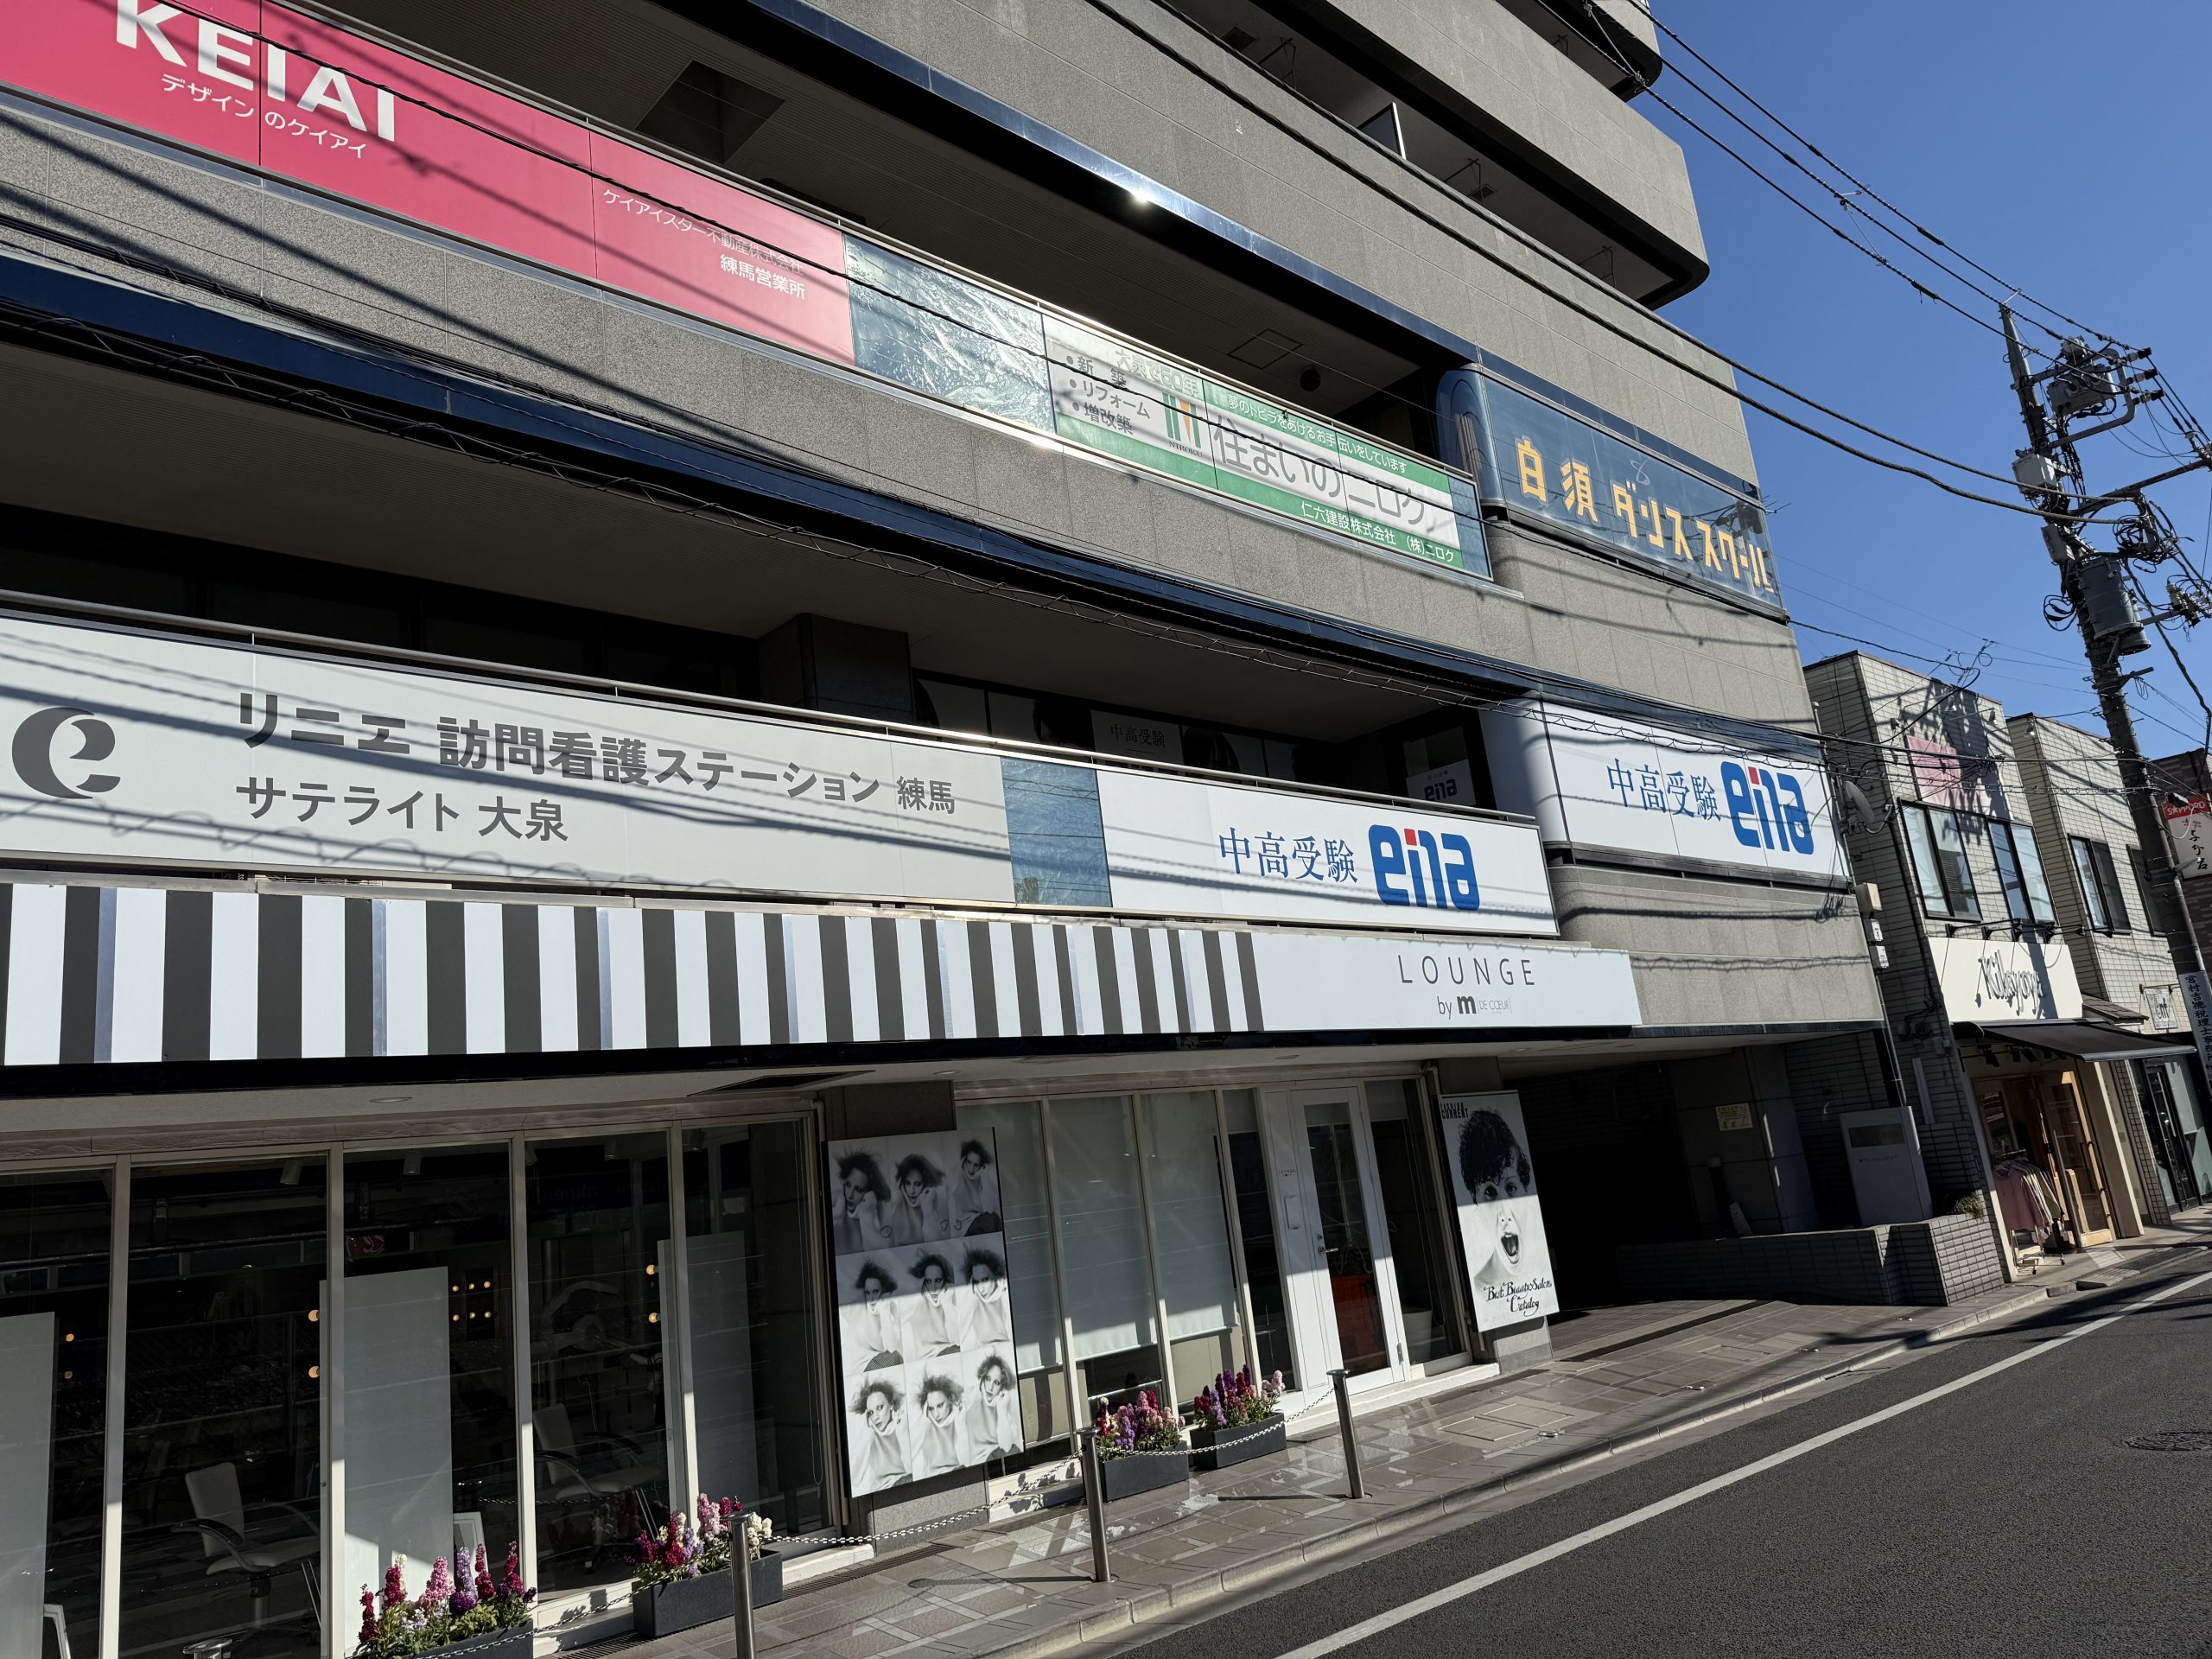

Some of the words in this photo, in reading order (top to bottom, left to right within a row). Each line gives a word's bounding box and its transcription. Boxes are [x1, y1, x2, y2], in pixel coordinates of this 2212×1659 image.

[117, 0, 395, 142] KEIAI
[720, 254, 806, 300] 練馬営業所
[1083, 380, 1151, 419] リフォーム
[1084, 402, 1134, 435] 増改築
[1168, 441, 1204, 458] NIROKU
[1212, 414, 1425, 525] 住まいのニロク
[1110, 723, 1166, 747] 中高受験
[437, 716, 880, 803] 訪問看護ステーション
[896, 775, 956, 815] 練馬
[236, 776, 460, 831] サテライト
[478, 796, 569, 842] 大泉
[1606, 758, 1721, 822] 中高受験
[1720, 761, 1815, 855] ena
[1218, 827, 1358, 883] 中高受験
[1369, 824, 1480, 911] ena
[1397, 955, 1535, 986] LOUNGE
[1436, 995, 1452, 1020] by
